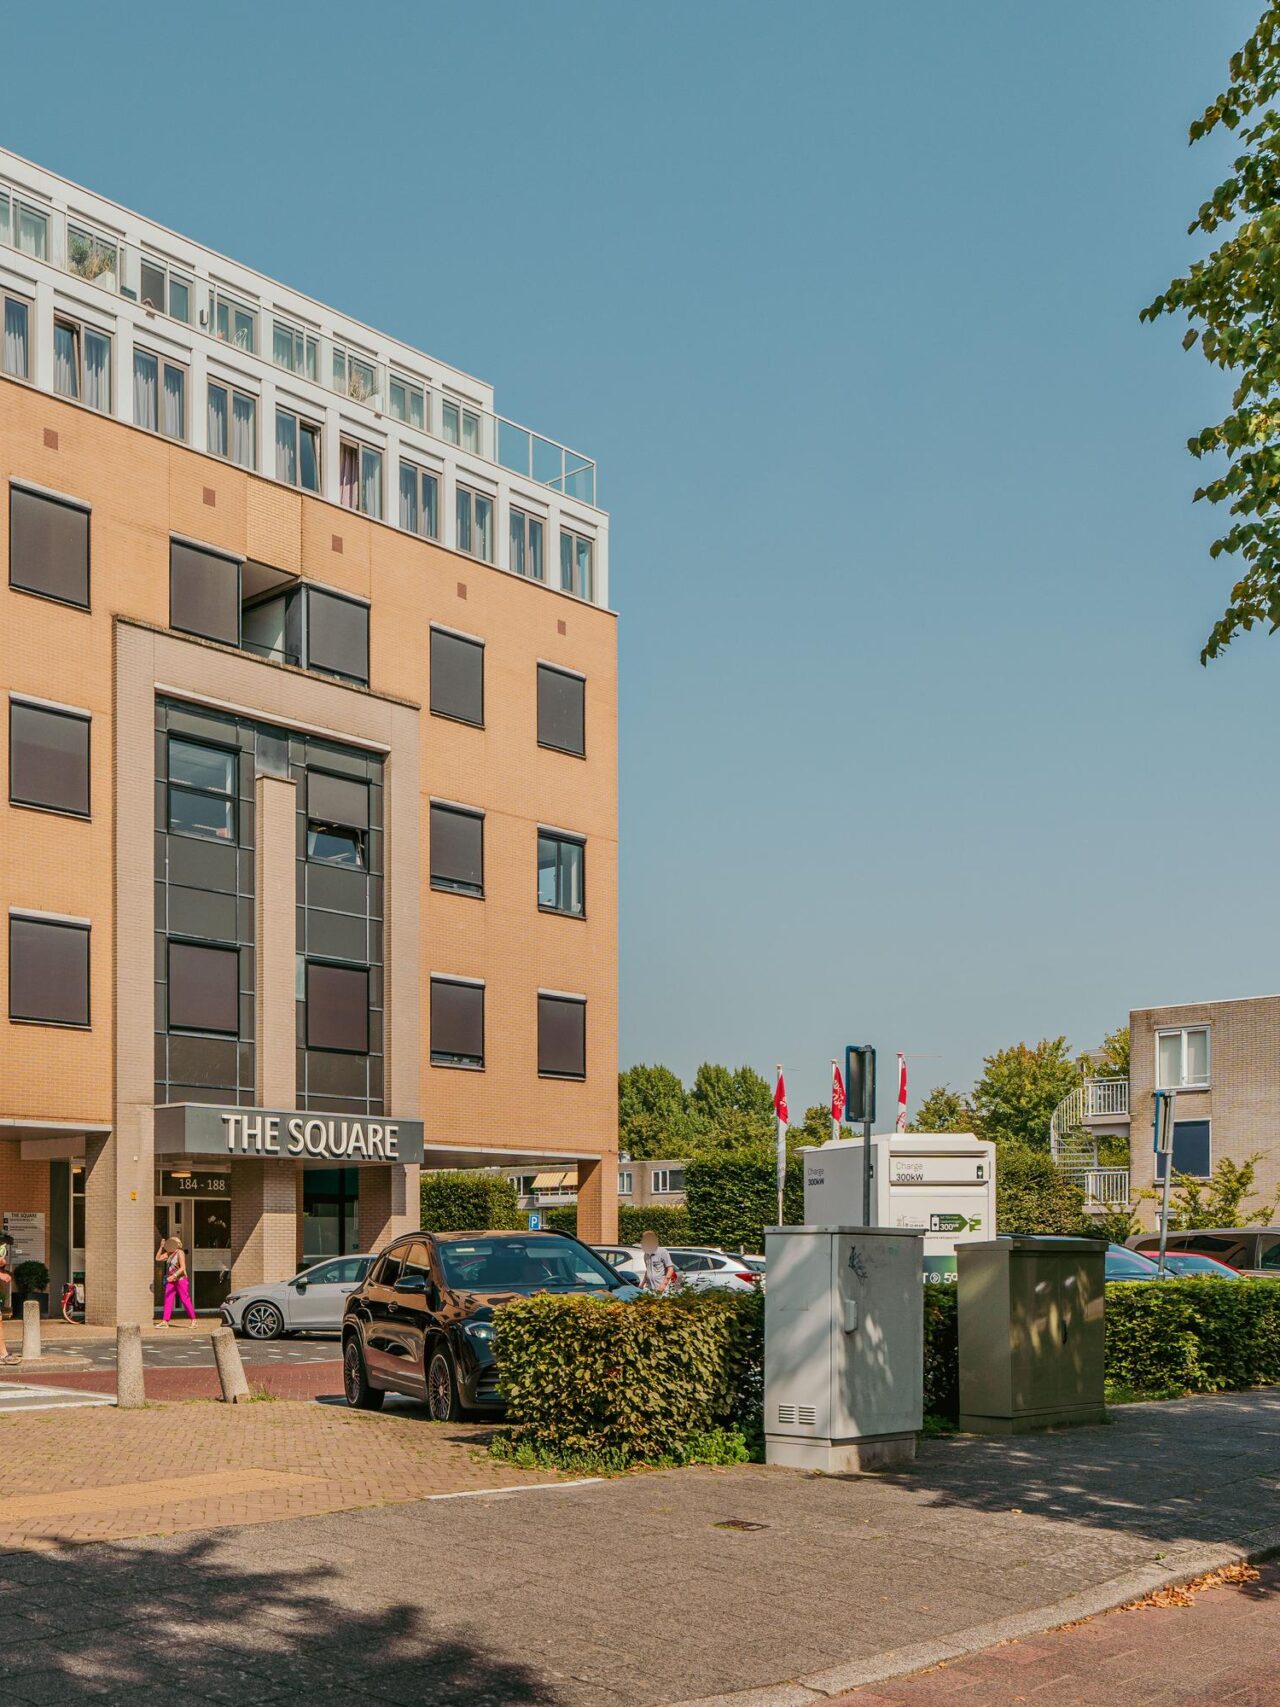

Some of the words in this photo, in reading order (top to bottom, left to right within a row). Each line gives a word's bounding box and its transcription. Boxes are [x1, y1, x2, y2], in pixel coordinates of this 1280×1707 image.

[222, 1114, 280, 1151] THE
[287, 1118, 400, 1158] SQUARE
[179, 1178, 197, 1189] 184
[207, 1179, 225, 1190] 188
[808, 1178, 825, 1186] 300kW
[531, 1216, 538, 1228] P
